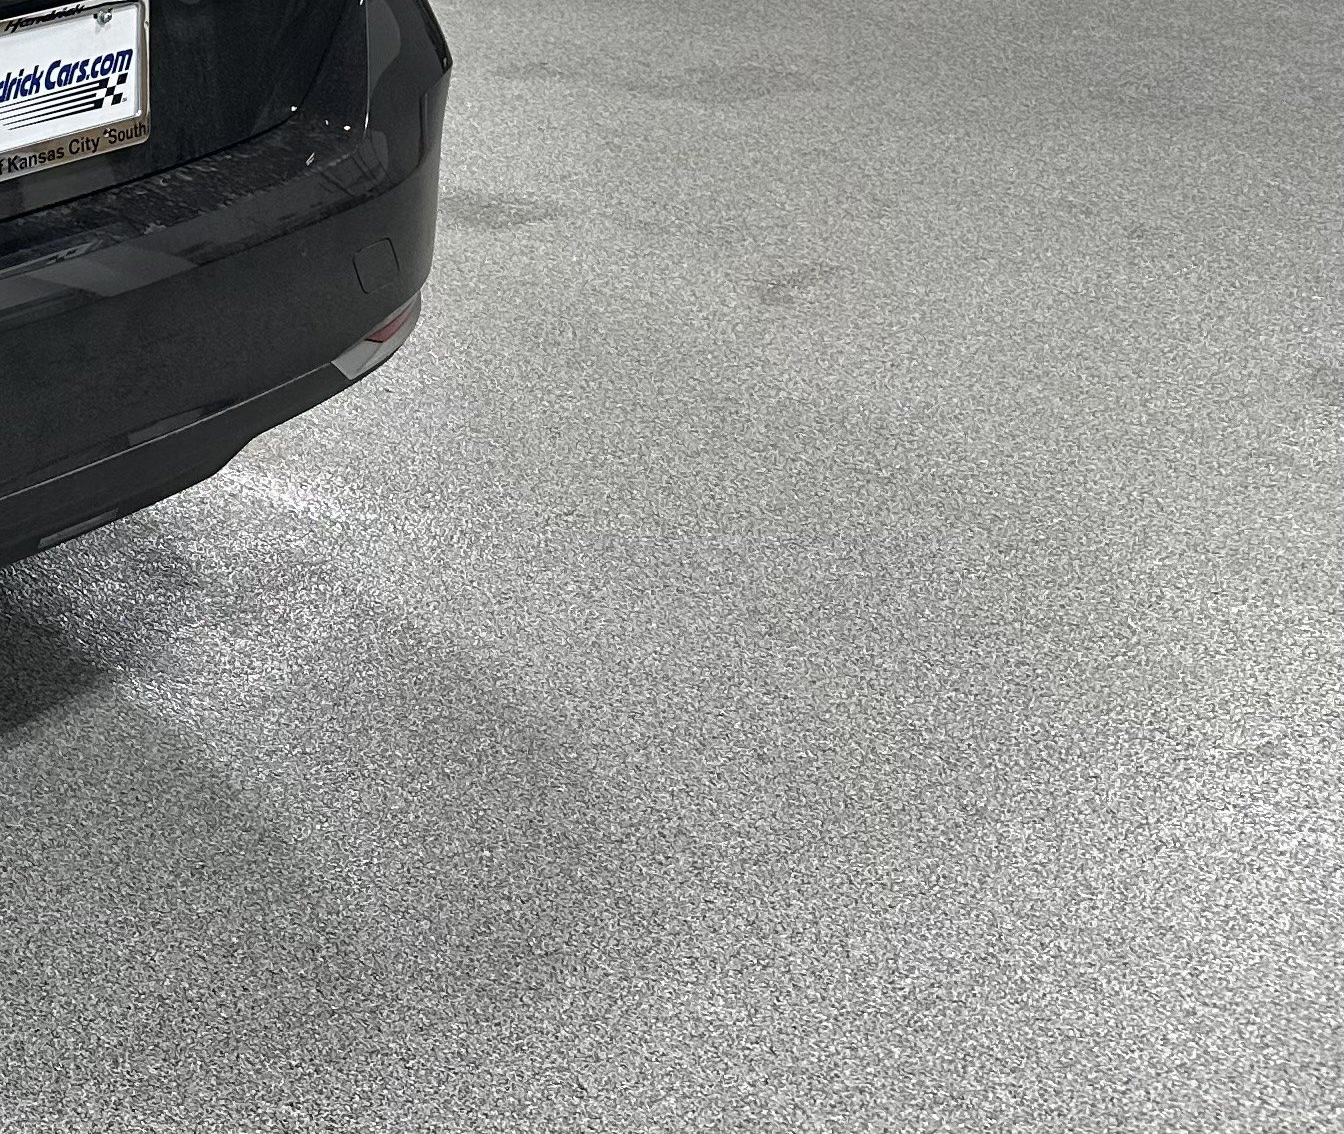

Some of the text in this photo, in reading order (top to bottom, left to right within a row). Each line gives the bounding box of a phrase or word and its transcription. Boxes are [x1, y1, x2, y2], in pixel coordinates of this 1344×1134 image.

[3, 3, 86, 33] Hendrick
[6, 145, 66, 174] Kansas
[68, 136, 101, 155] City
[108, 122, 148, 145] South
